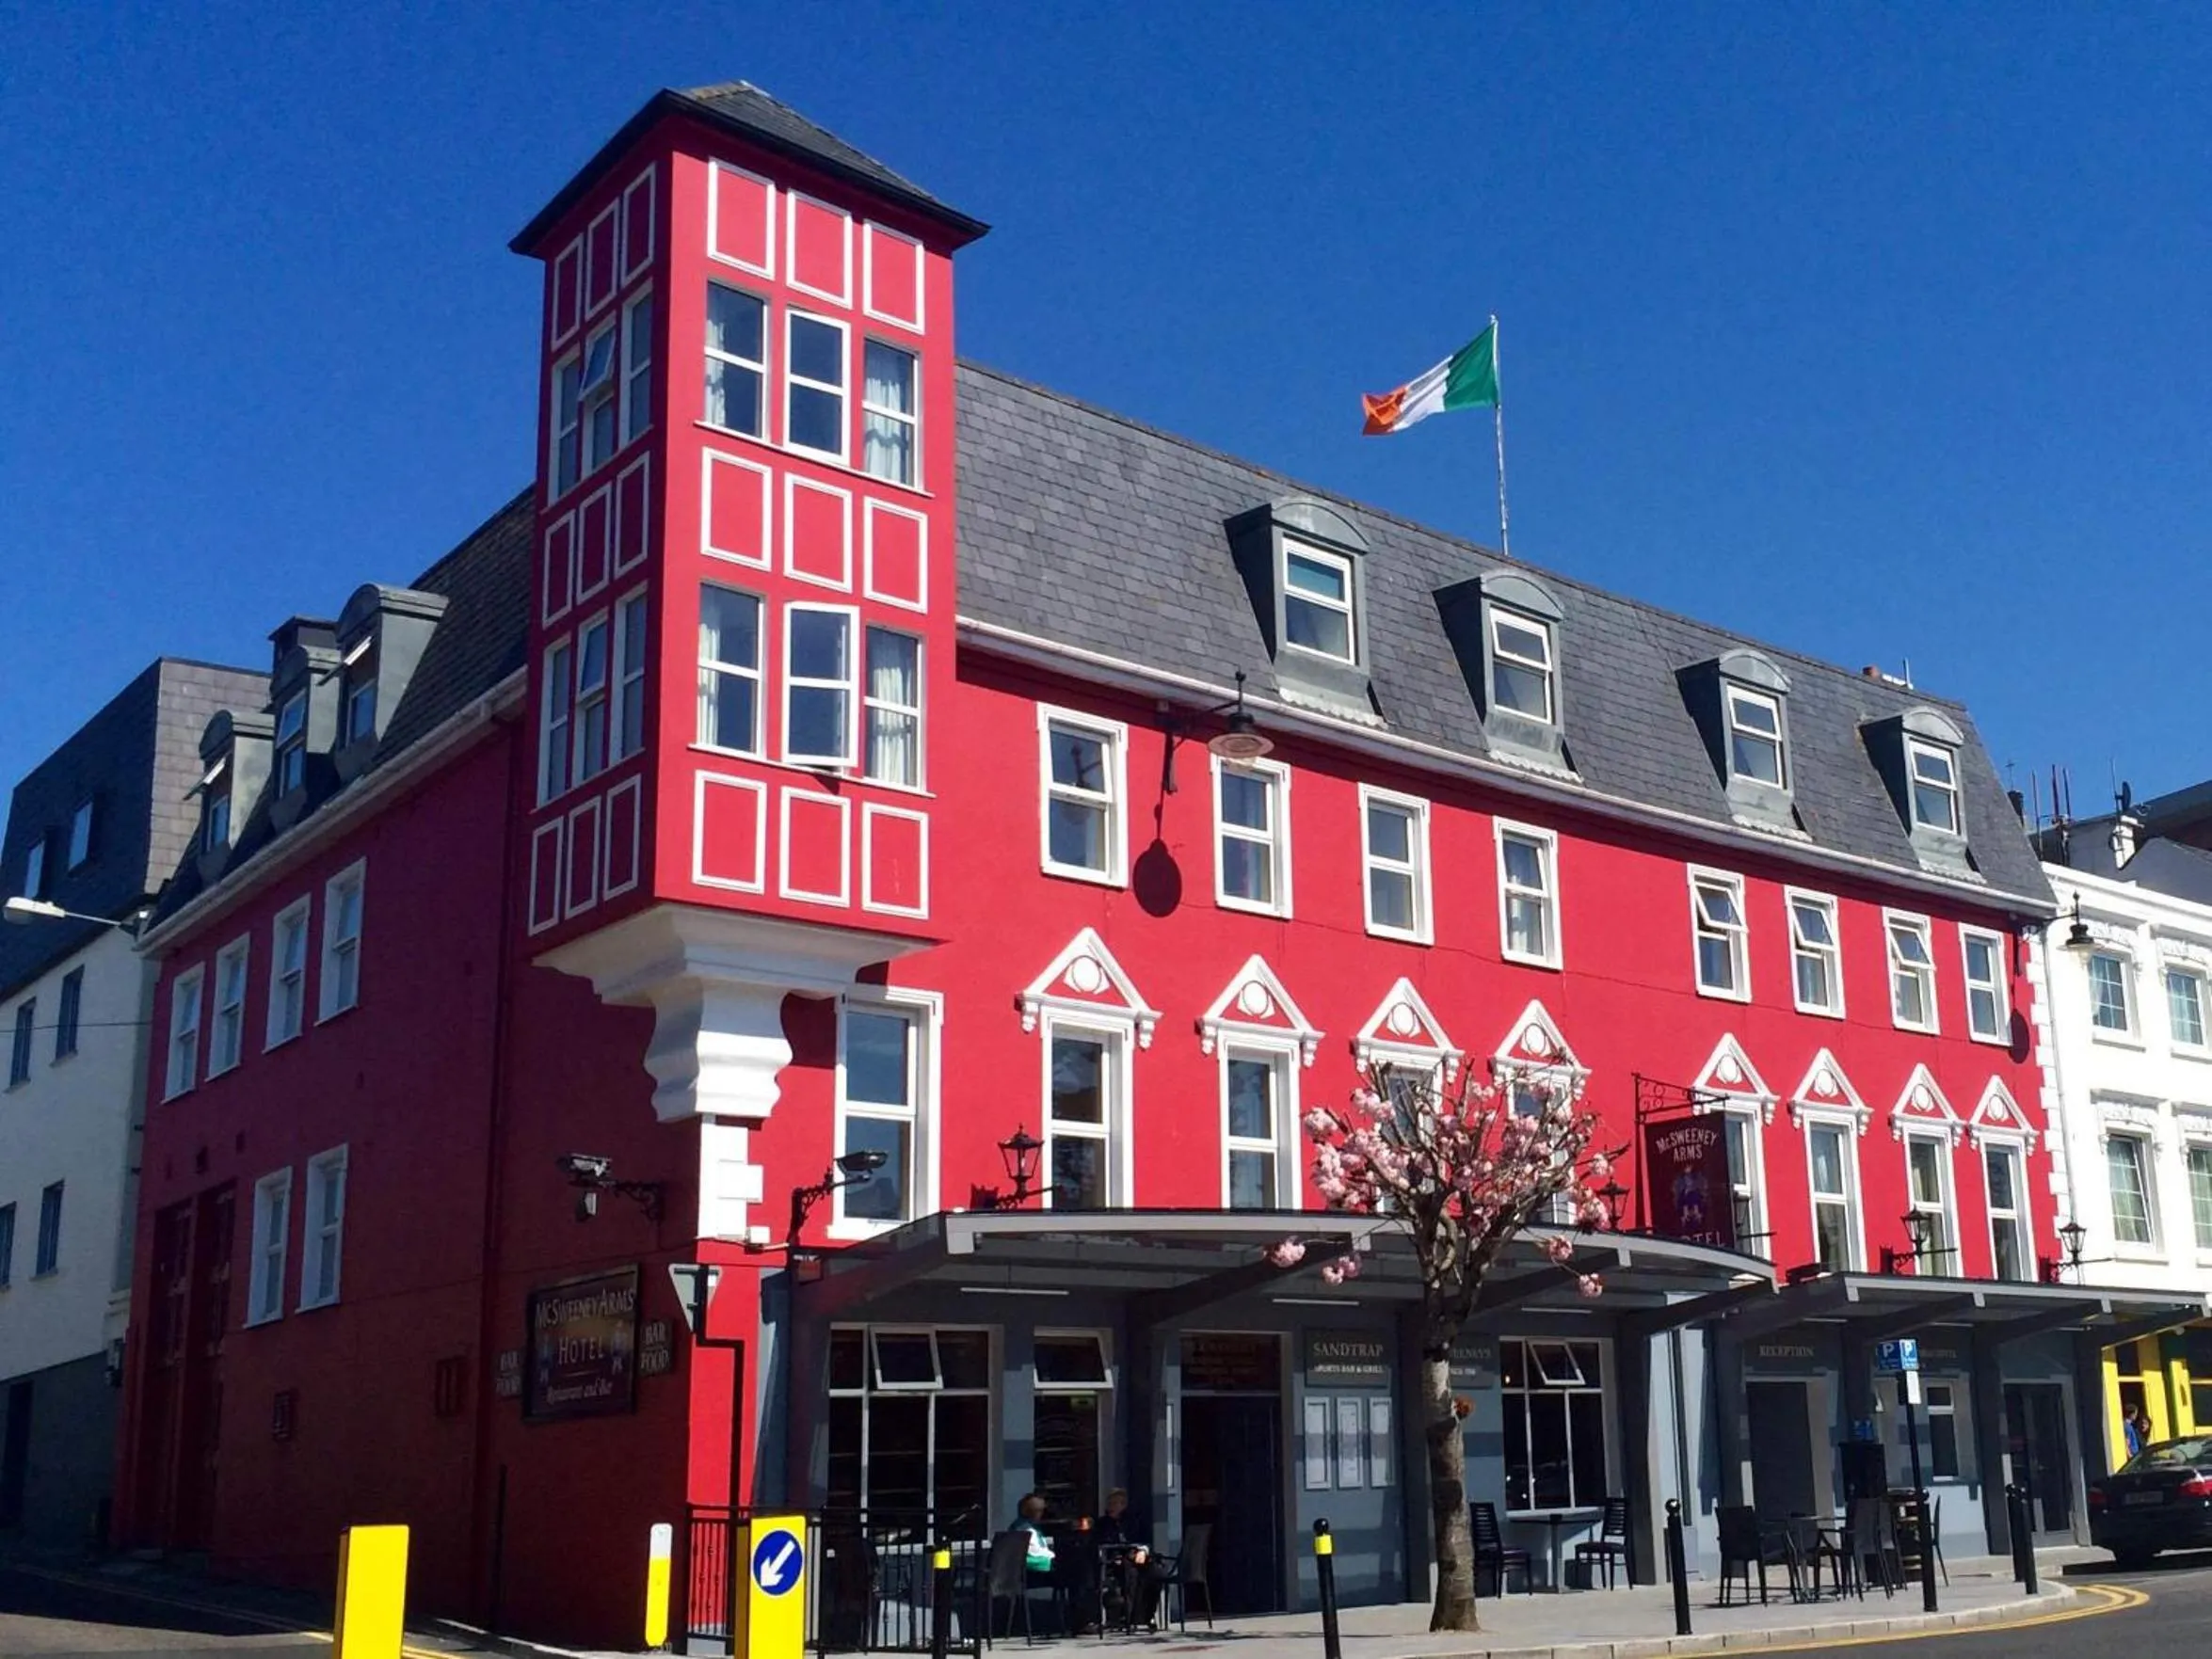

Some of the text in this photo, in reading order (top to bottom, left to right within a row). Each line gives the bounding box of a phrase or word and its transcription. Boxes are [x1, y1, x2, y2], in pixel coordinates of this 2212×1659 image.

[1673, 1144, 1703, 1163] ARMS
[598, 1287, 634, 1317] ARMS
[645, 1322, 665, 1345] BAR
[558, 1335, 604, 1364] HOTEL
[641, 1349, 669, 1372] FOOD
[1313, 1342, 1384, 1358] SANDTRAP
[1758, 1346, 1814, 1357] RECEPTION
